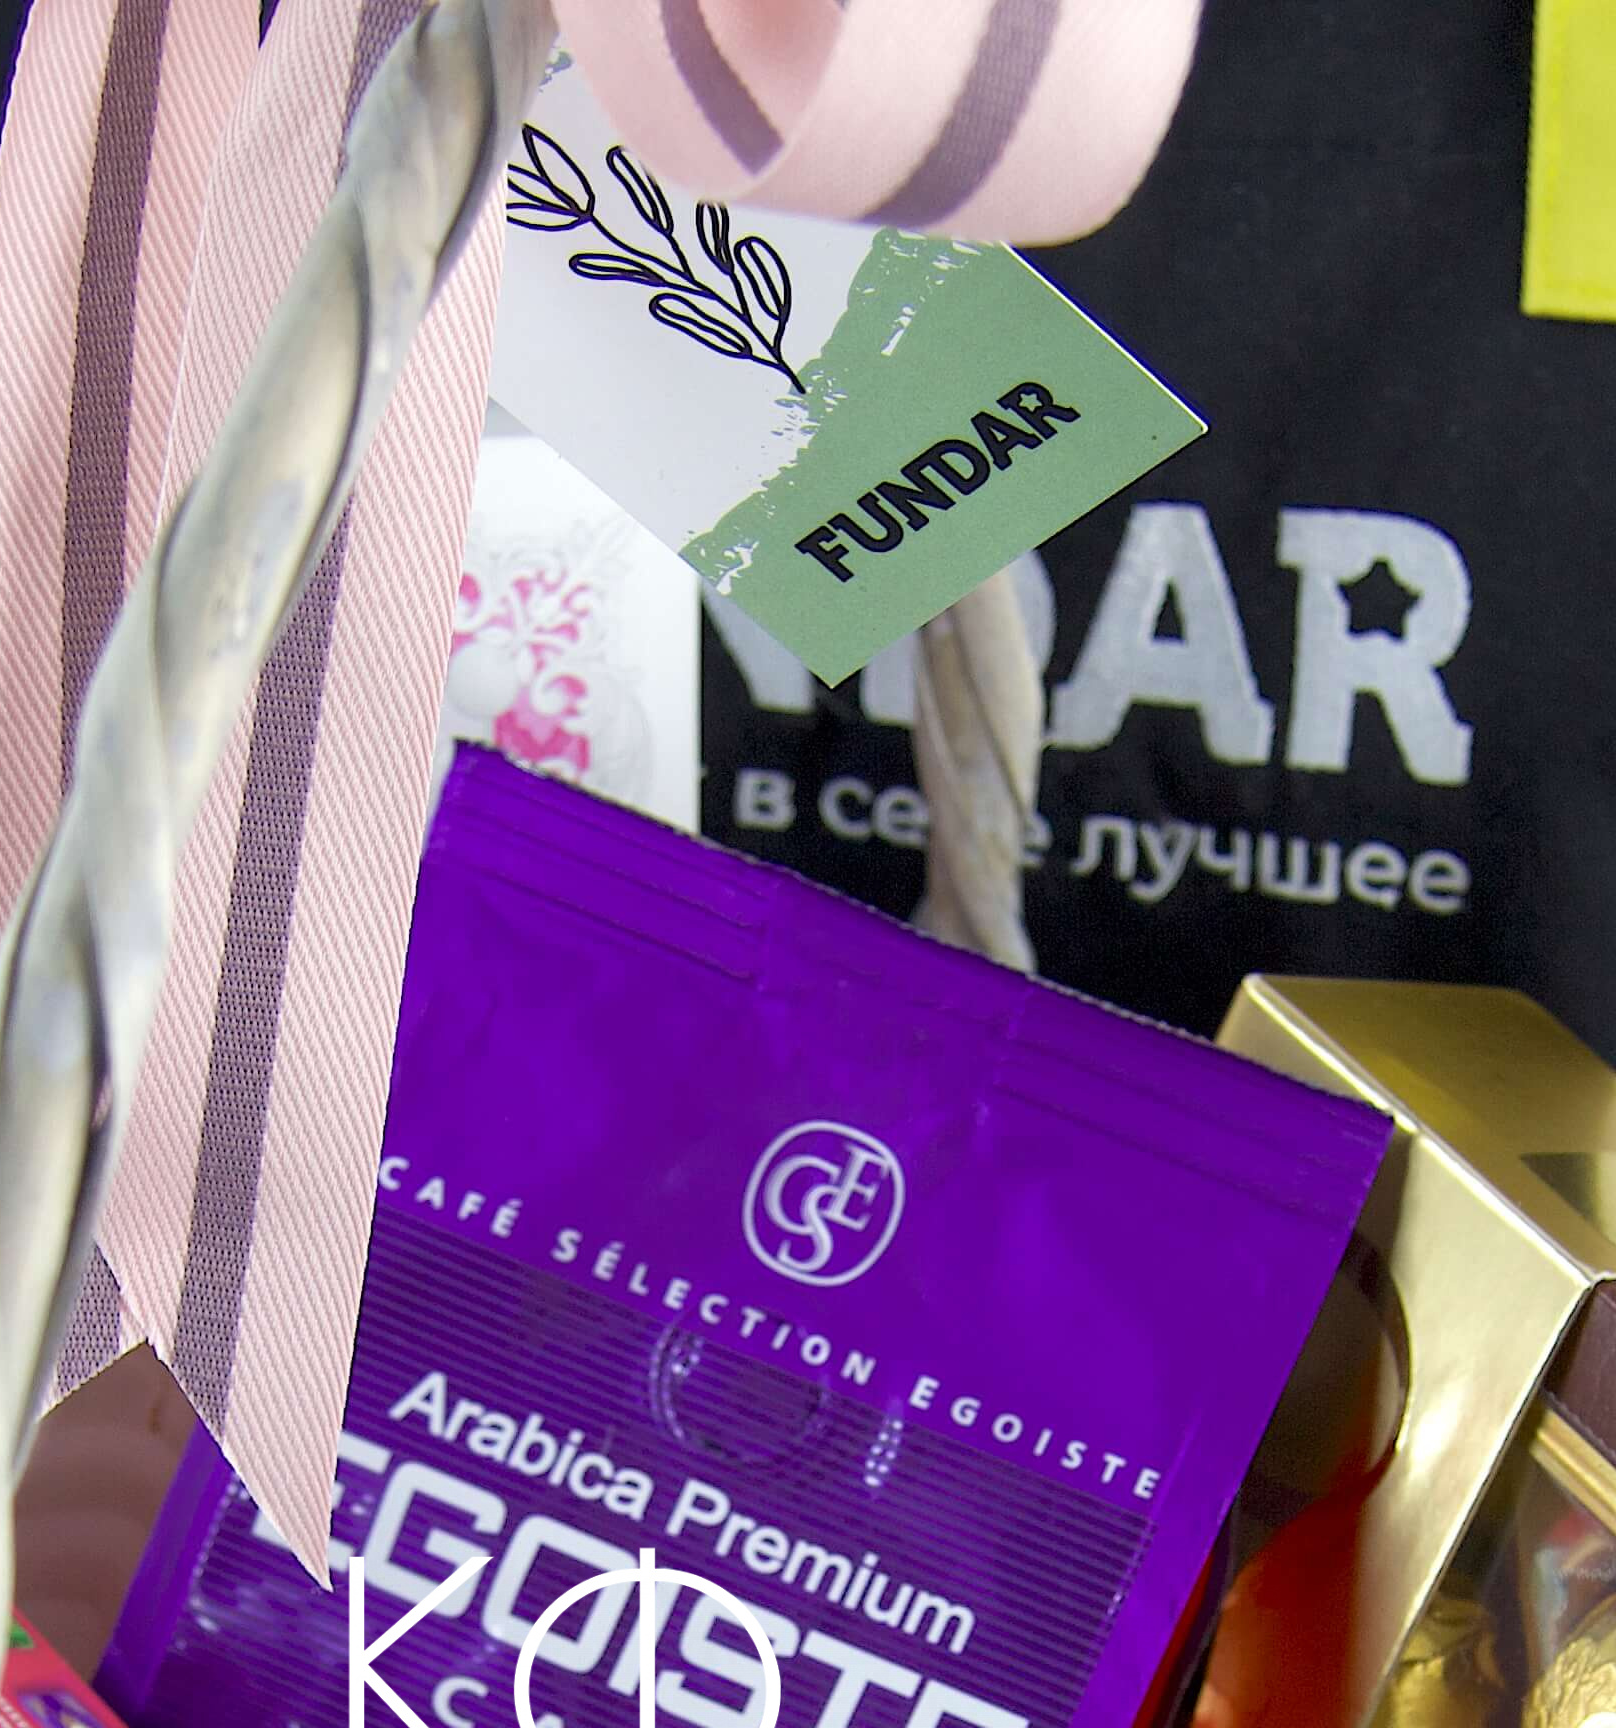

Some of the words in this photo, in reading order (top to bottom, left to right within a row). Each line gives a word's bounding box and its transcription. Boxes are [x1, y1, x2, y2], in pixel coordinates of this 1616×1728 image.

[795, 379, 1083, 583] FUNDAR
[703, 500, 1473, 787] AR
[818, 778, 1052, 866] сее
[1074, 816, 1471, 914] лучшее
[378, 1156, 523, 1239] CAFÉ
[550, 1228, 876, 1386] SÉLECTION
[908, 1375, 1161, 1499] EGOISTE
[389, 1371, 657, 1523] Arabica
[665, 1479, 978, 1655] Premium
